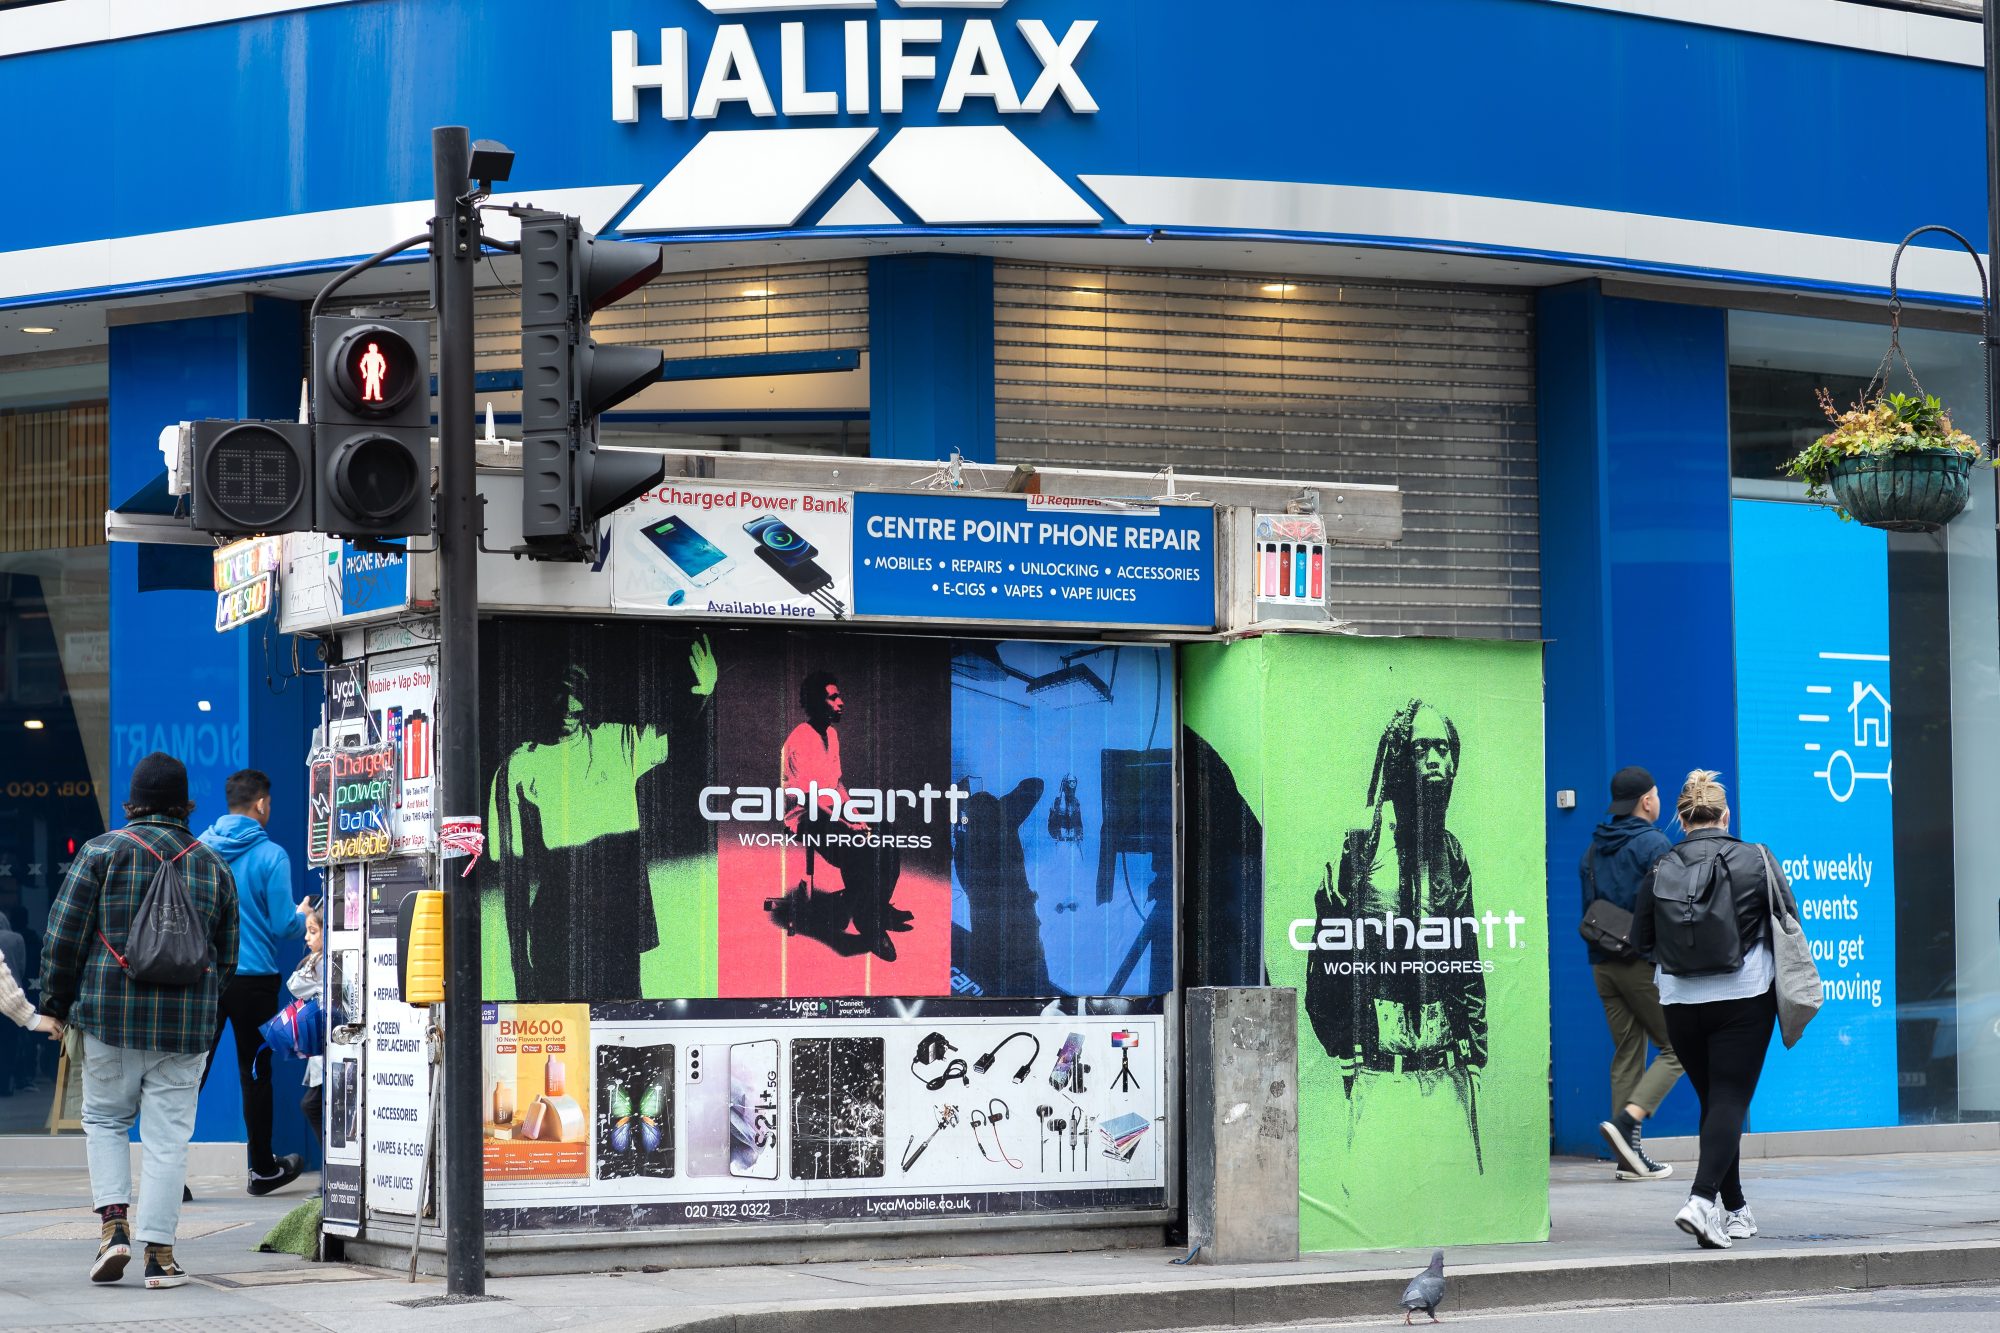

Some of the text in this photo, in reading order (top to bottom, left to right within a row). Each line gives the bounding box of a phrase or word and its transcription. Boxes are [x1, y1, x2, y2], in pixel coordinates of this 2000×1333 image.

[611, 19, 1100, 123] HALIFAX
[639, 487, 848, 513] e-Charged Power Bank
[1031, 494, 1044, 505] ID
[866, 515, 1200, 551] CENTRE POINT PHONE REPAIR
[346, 552, 373, 575] PHONE
[875, 556, 1200, 581] MOBILES REPAIRS UNLOCKING ACCESSORIES
[244, 580, 267, 614] SHOP
[943, 582, 1136, 602] E-CIGS VAPES VAPE JUICES
[706, 600, 816, 617] Available Here
[332, 679, 355, 703] Lyca
[368, 678, 390, 694] Mobile
[398, 674, 411, 691] Vap
[413, 671, 431, 688] Shop
[335, 748, 393, 777] Charged
[336, 781, 388, 807] power
[698, 780, 969, 824] carhartt
[338, 803, 383, 831] bank
[330, 830, 391, 858] available
[738, 832, 932, 849] WORK IN PROGRESS
[1813, 852, 1873, 888] weekly
[1802, 894, 1859, 920] events
[1288, 909, 1526, 951] carhartt
[377, 953, 398, 967] MOBIL
[1837, 934, 1865, 968] get
[1323, 960, 1495, 975] WORK IN PROGRESS
[377, 987, 400, 1000] REPAIR
[1821, 972, 1882, 1008] moving
[789, 998, 818, 1013] Lyca
[376, 1021, 400, 1034] SCREEN
[500, 1020, 563, 1035] BM600
[376, 1039, 421, 1053] REPLACEMENT
[376, 1072, 414, 1087] UNLOCKING
[376, 1106, 418, 1122] ACCESSORIES
[377, 1140, 424, 1157] VAPES & E-CIGS
[376, 1174, 413, 1190] VAPE JUICES
[684, 1203, 771, 1218] 020 7132 0322
[866, 1196, 971, 1212] LycaMobile.co.uk
